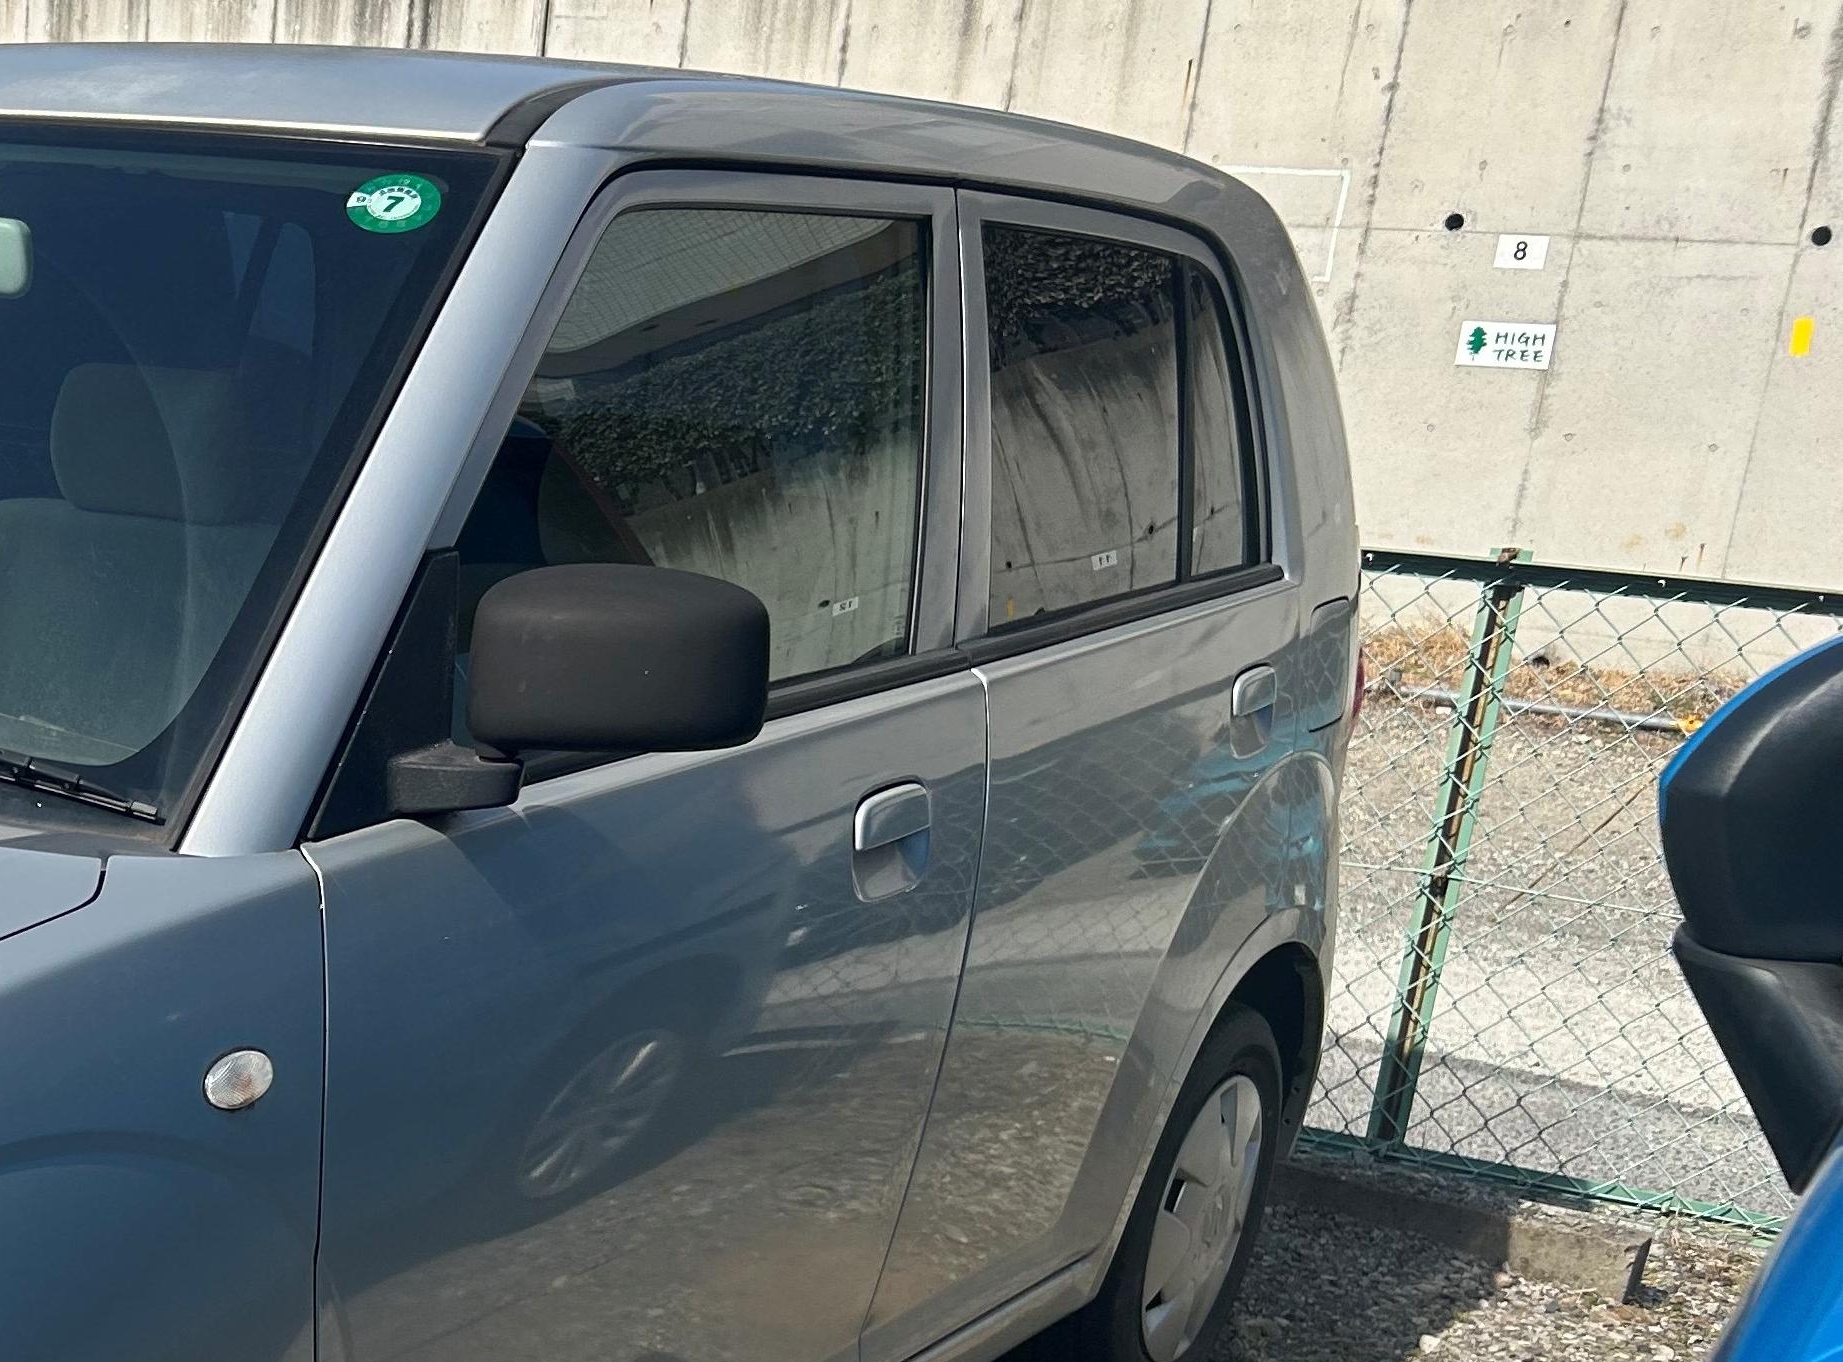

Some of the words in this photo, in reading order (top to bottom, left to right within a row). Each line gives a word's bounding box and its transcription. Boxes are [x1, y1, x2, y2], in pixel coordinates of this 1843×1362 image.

[383, 195, 405, 213] 7
[1513, 241, 1528, 261] 8
[1495, 332, 1546, 347] HIGH
[1493, 349, 1544, 362] TREE
